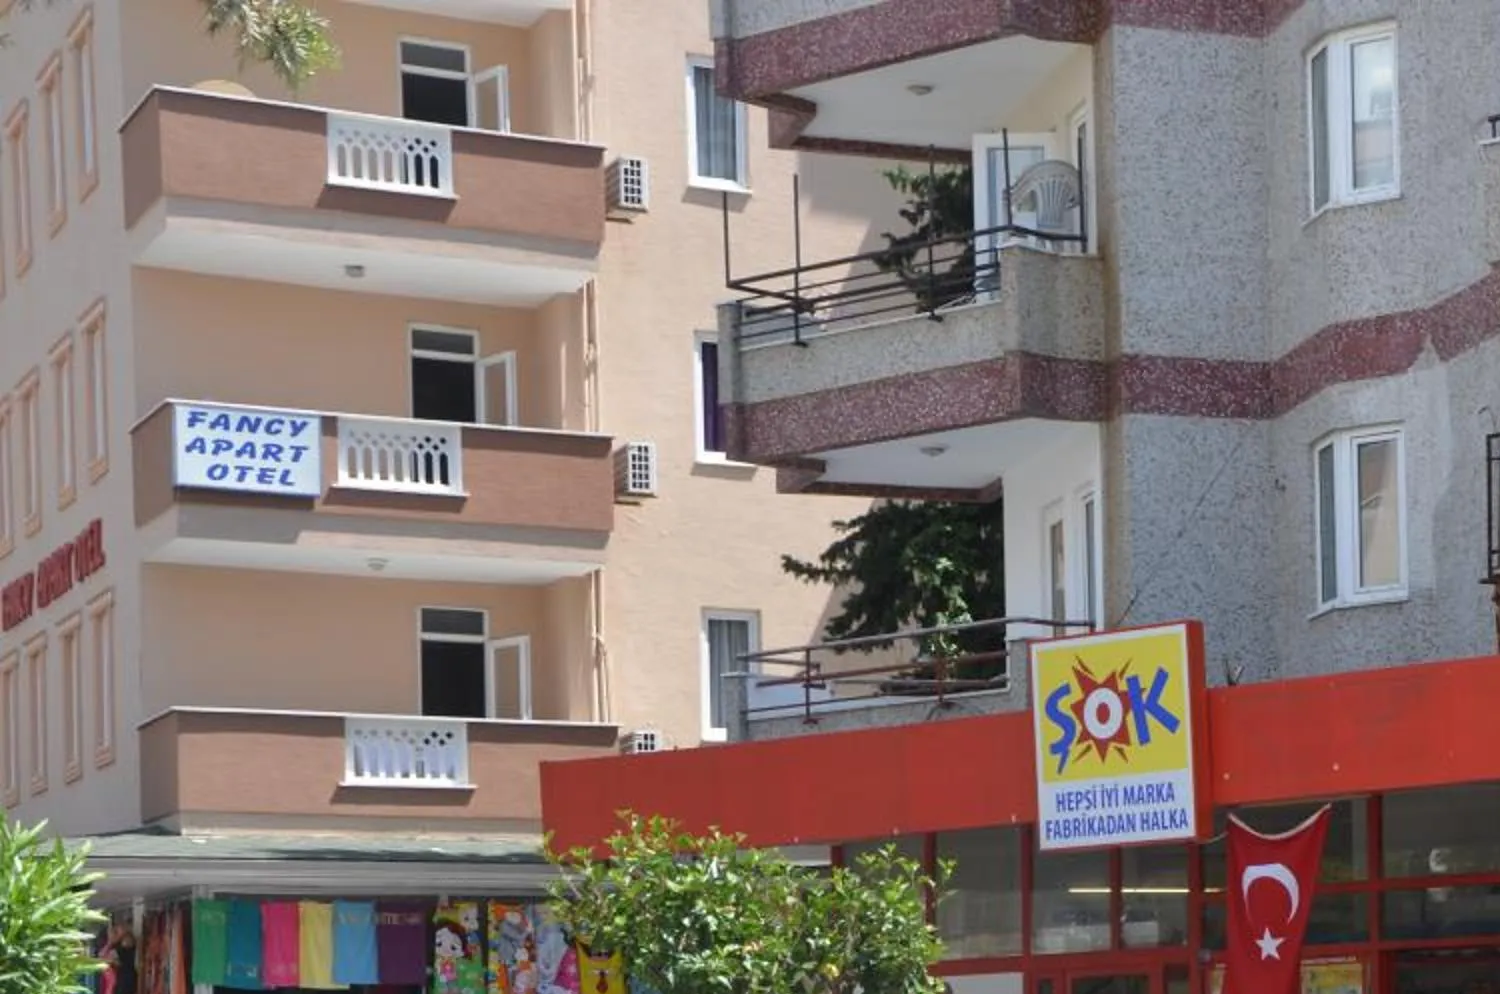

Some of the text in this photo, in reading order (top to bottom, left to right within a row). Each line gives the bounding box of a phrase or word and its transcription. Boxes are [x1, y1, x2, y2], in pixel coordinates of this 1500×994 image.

[187, 410, 310, 437] FANCY
[185, 437, 309, 463] APART
[206, 463, 296, 486] OTEL
[1045, 666, 1181, 775] ŞOK
[1056, 782, 1175, 812] HEPSİ İYİ MARKA
[1046, 808, 1189, 840] FABRİKADAN HALKA
